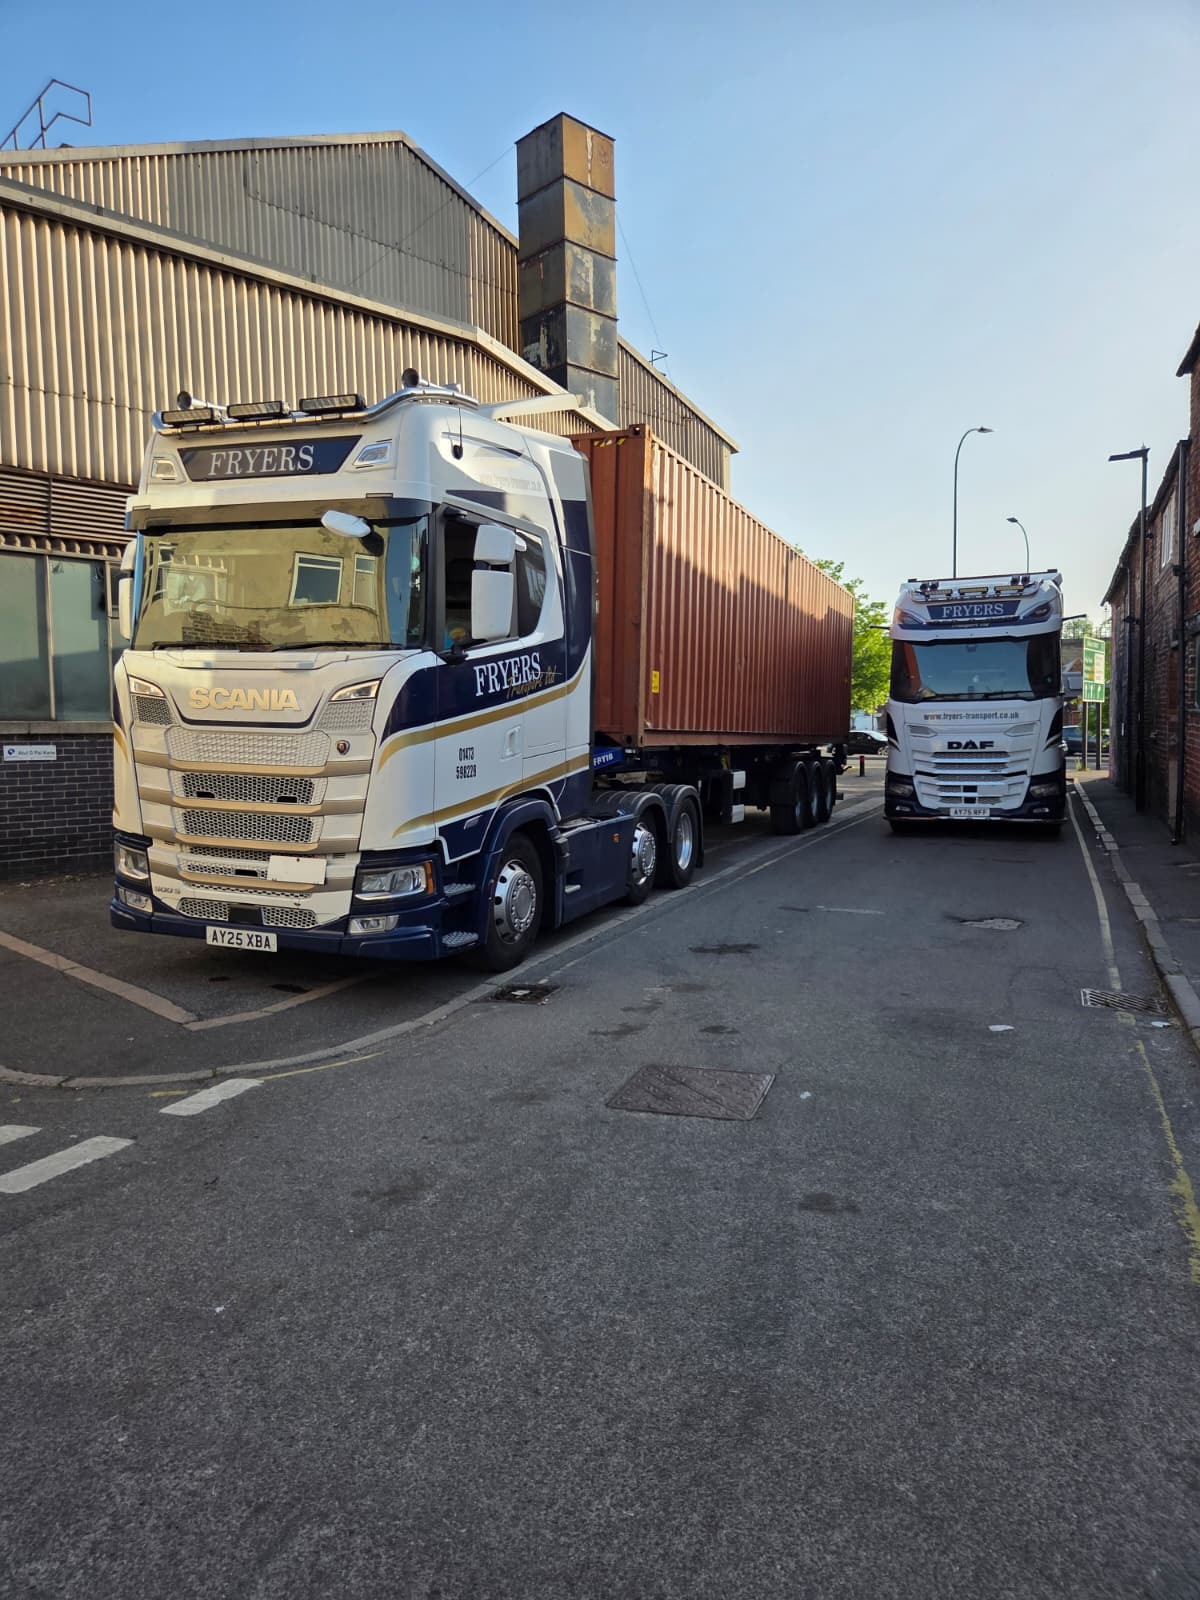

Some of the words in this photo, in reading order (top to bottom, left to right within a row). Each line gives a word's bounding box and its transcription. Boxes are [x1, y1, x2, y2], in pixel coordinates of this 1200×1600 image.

[208, 445, 314, 476] FRYERS
[942, 603, 1004, 618] FRYERS
[474, 652, 541, 697] FRYERS
[189, 687, 300, 712] SCANIA
[923, 711, 1020, 720] www.fryers-transport.co.uk
[458, 746, 475, 762] 01473
[947, 740, 994, 750] DAF
[211, 928, 243, 947] AY25
[246, 933, 271, 950] XBA
